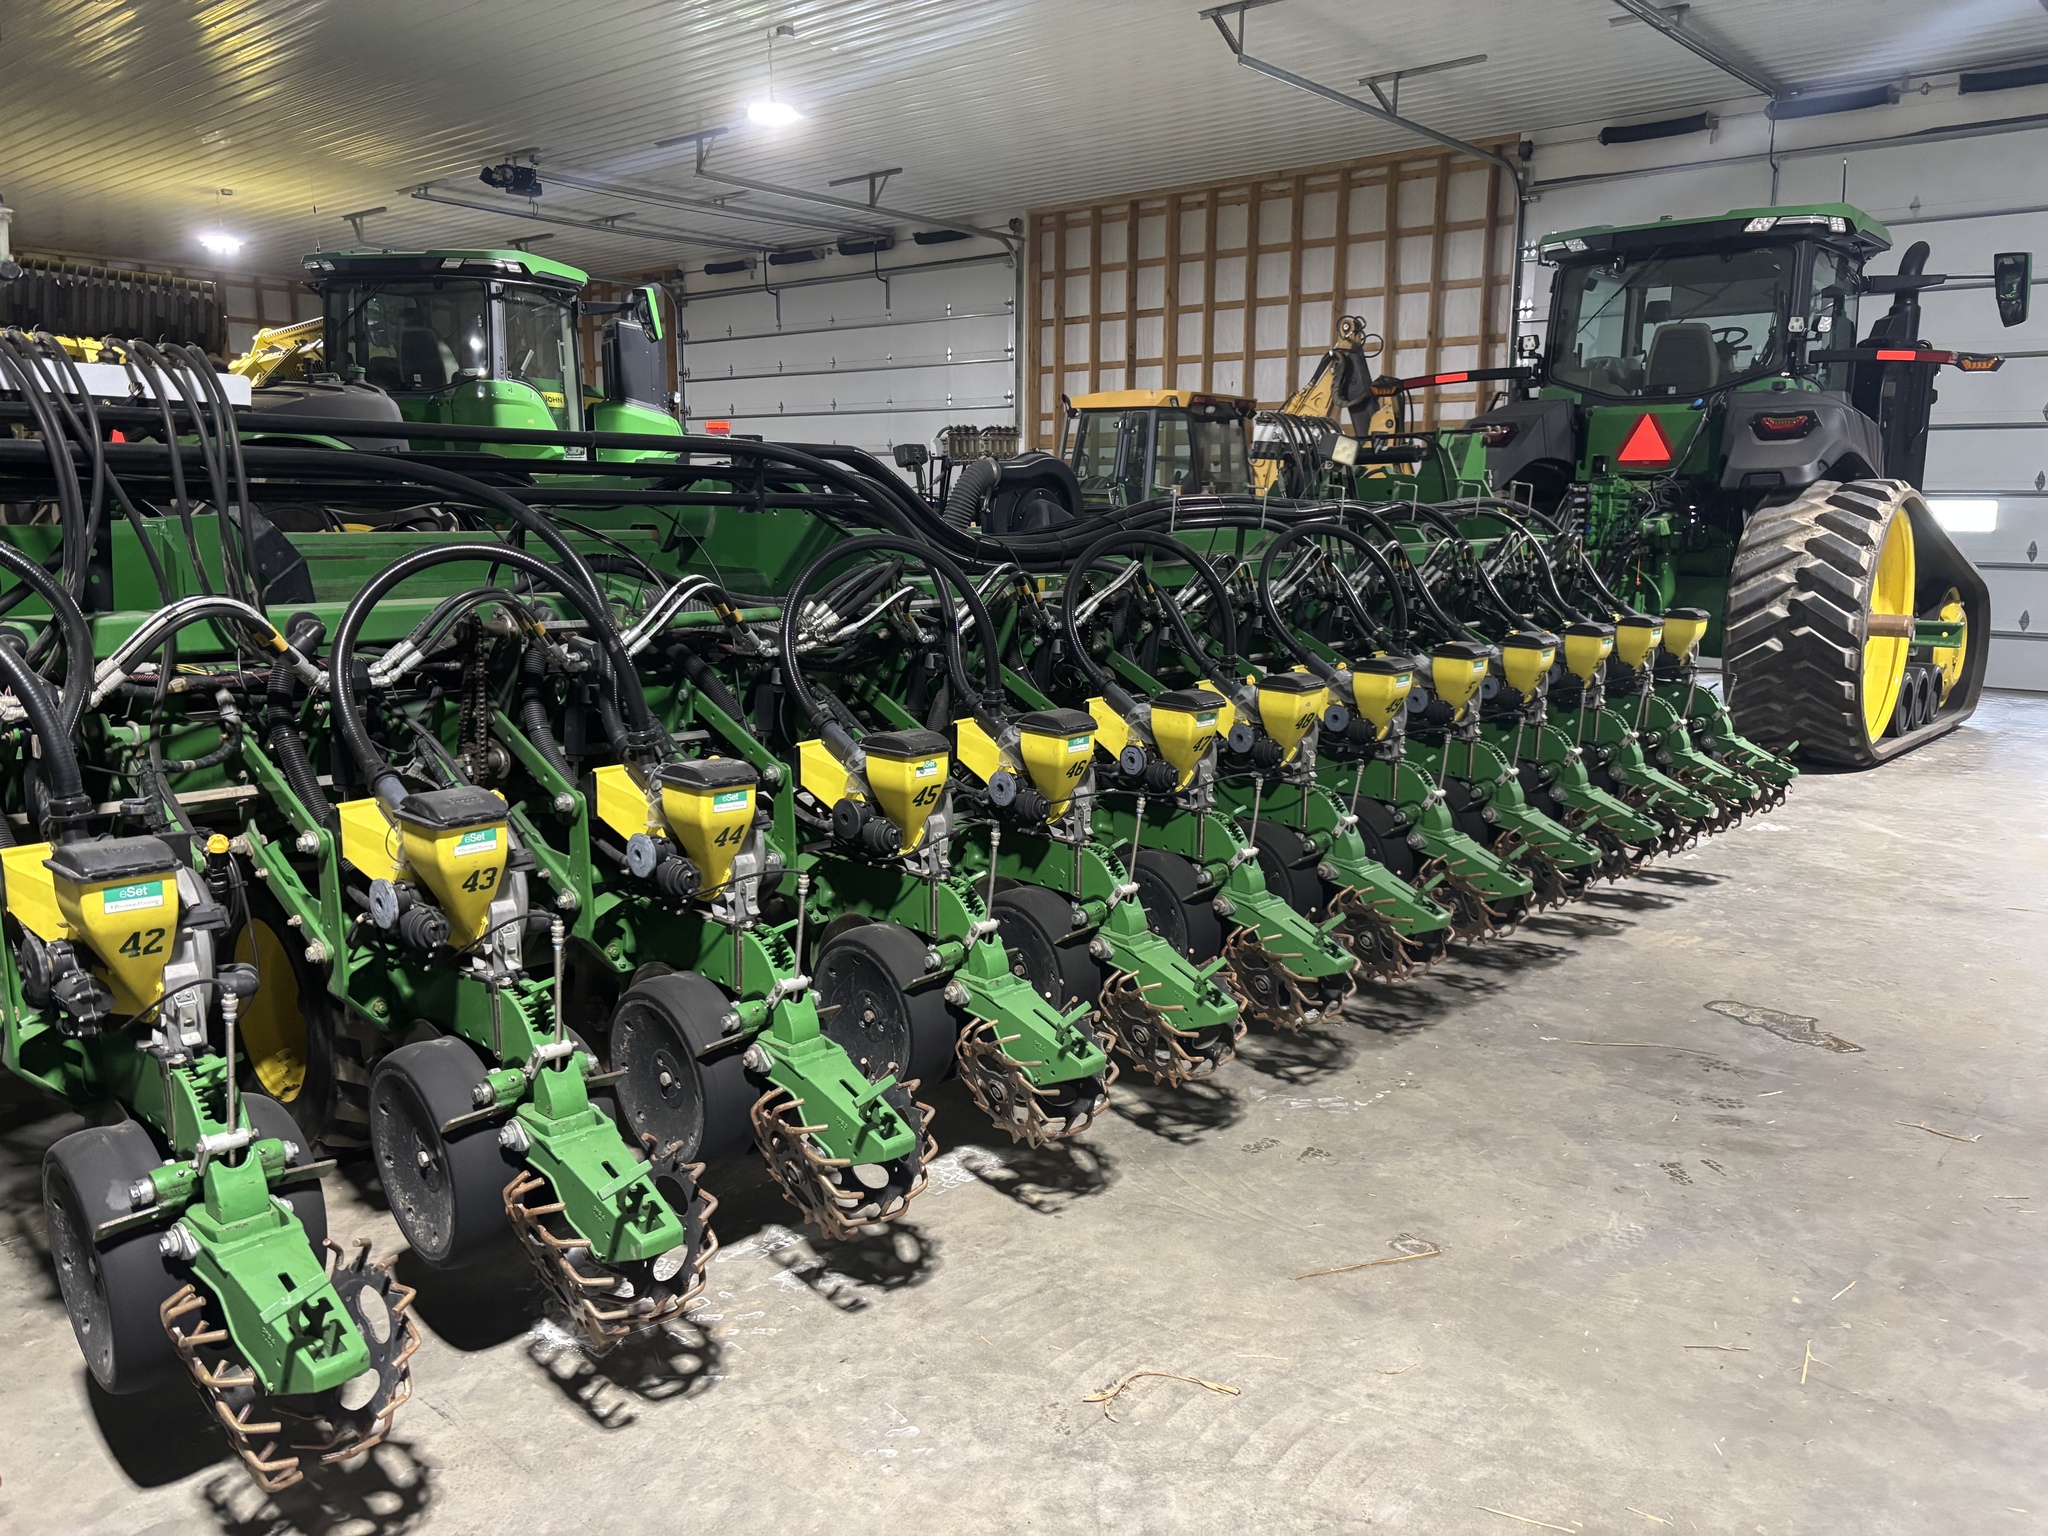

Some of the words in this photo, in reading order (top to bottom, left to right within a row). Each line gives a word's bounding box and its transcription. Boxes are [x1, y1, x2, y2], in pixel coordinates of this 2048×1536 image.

[1295, 712, 1315, 730] 48
[1193, 735, 1213, 752] 47
[1066, 759, 1087, 779] 46
[722, 793, 739, 803] eSet
[912, 784, 942, 807] 45
[464, 832, 486, 843] eSet
[714, 824, 746, 848] 44
[462, 867, 498, 893] 43
[119, 885, 148, 899] eSet
[119, 928, 166, 958] 42
